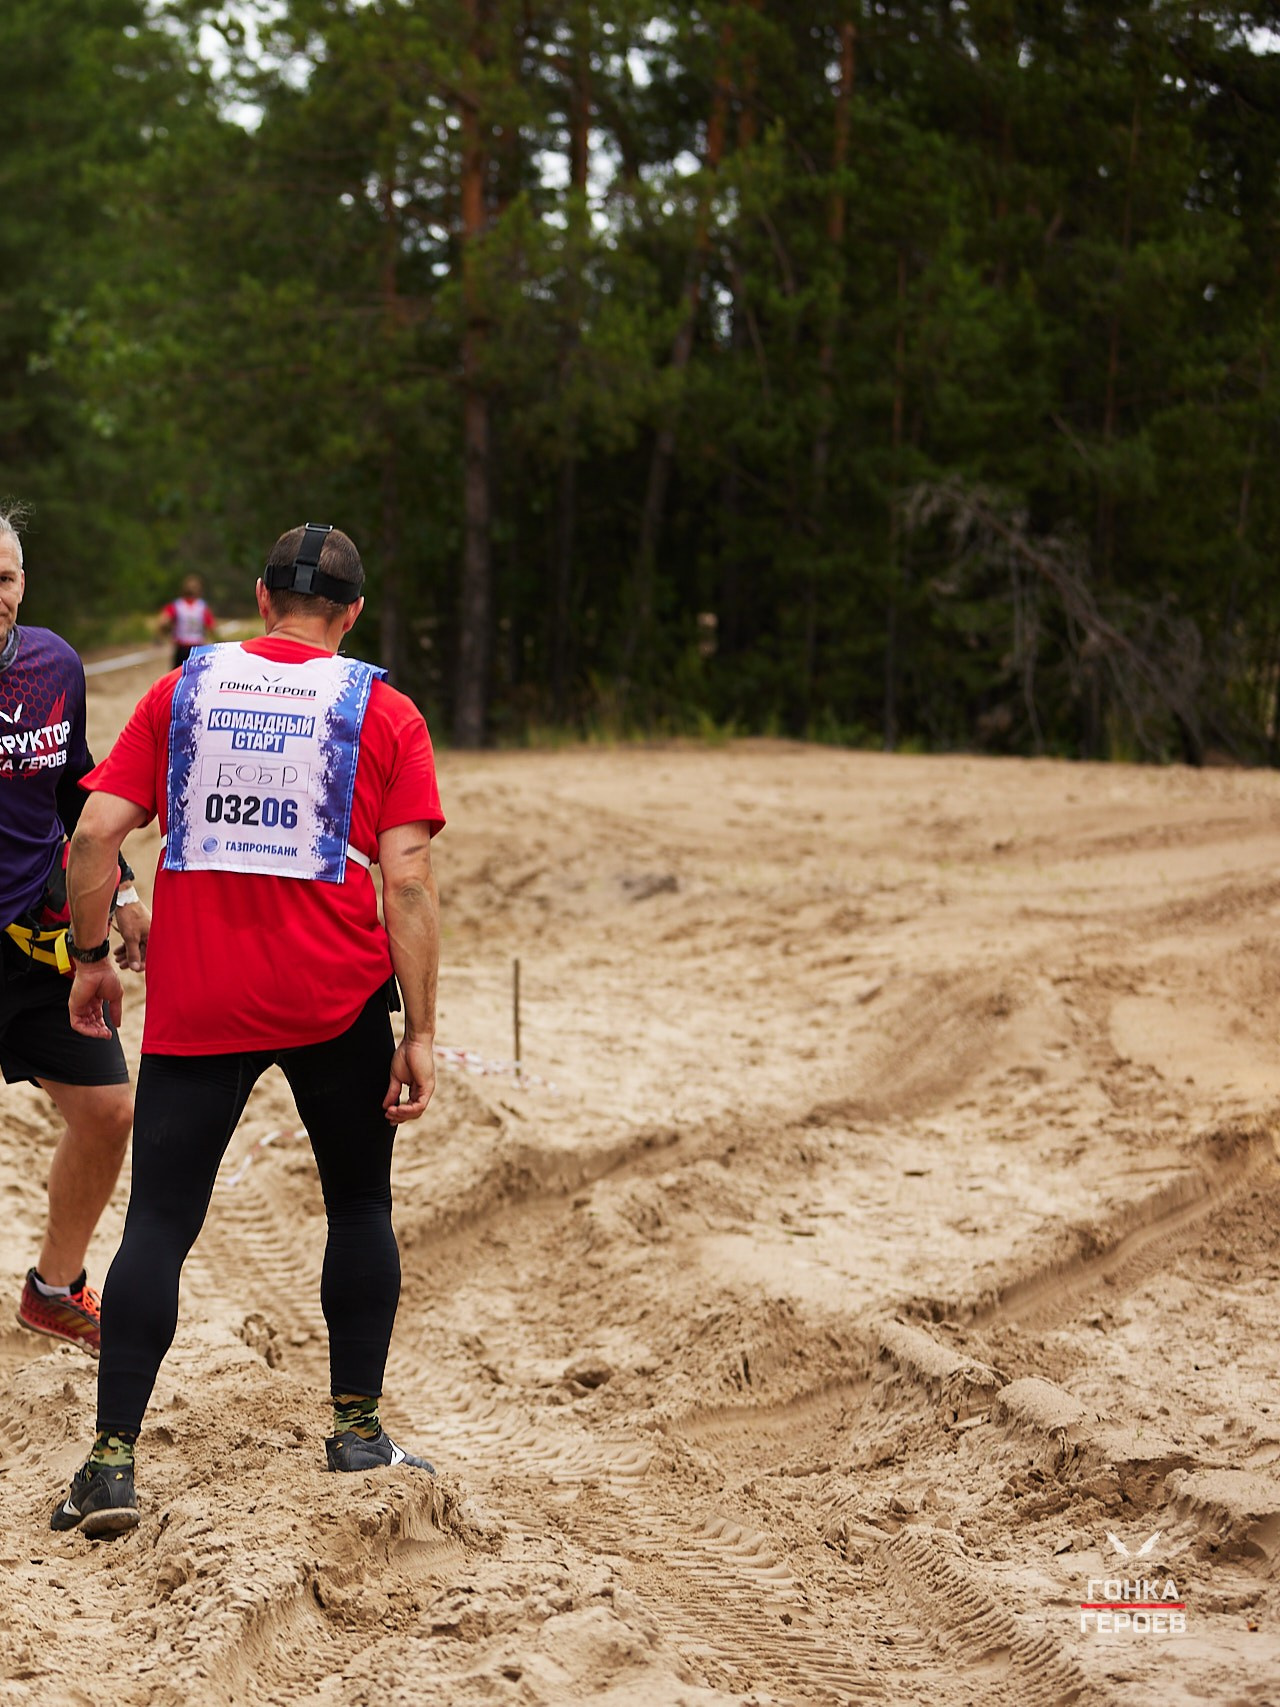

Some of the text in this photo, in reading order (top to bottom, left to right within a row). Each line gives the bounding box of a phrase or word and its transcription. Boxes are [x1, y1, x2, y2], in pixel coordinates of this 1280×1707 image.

[220, 681, 317, 697] ГОНКА ГЕРОЕВ
[209, 711, 314, 735] КОМАНДНЫЙ
[235, 733, 282, 752] СТАРТ
[19, 749, 67, 770] ГЕРОЕВ
[216, 763, 298, 789] БОБР
[205, 793, 298, 829] 03206
[225, 841, 298, 857] ГАЗПРОМБАНК
